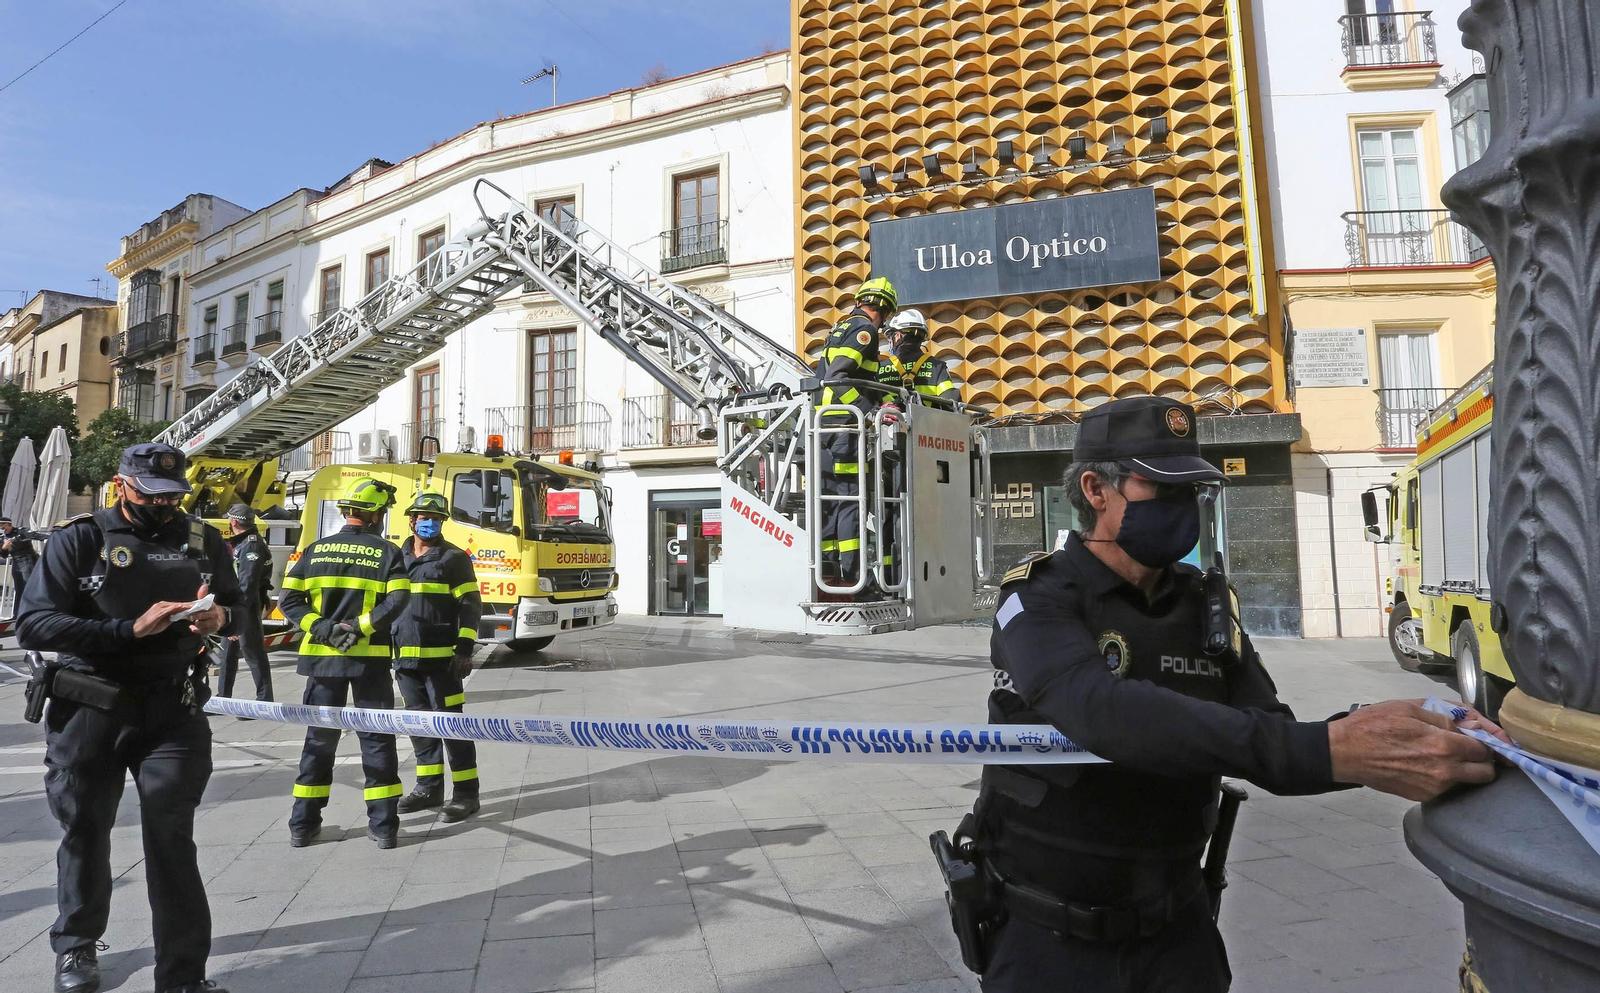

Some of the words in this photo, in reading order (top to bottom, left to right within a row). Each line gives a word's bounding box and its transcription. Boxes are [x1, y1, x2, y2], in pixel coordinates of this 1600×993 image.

[914, 243, 993, 272] Ulloa
[1006, 232, 1107, 269] Optico
[918, 434, 964, 452] MAGIRUS
[730, 496, 794, 548] MAGIRUS
[314, 543, 382, 558] BOMBEROS
[478, 549, 506, 558] CBPC
[667, 538, 680, 556] G
[310, 556, 343, 565] provincia
[356, 557, 380, 568] CÁDIZ
[480, 582, 516, 596] E-19
[447, 717, 490, 740] POLICIA
[482, 718, 523, 742] LOCAL
[592, 722, 656, 749] POLICIA
[647, 724, 709, 750] LOCAL
